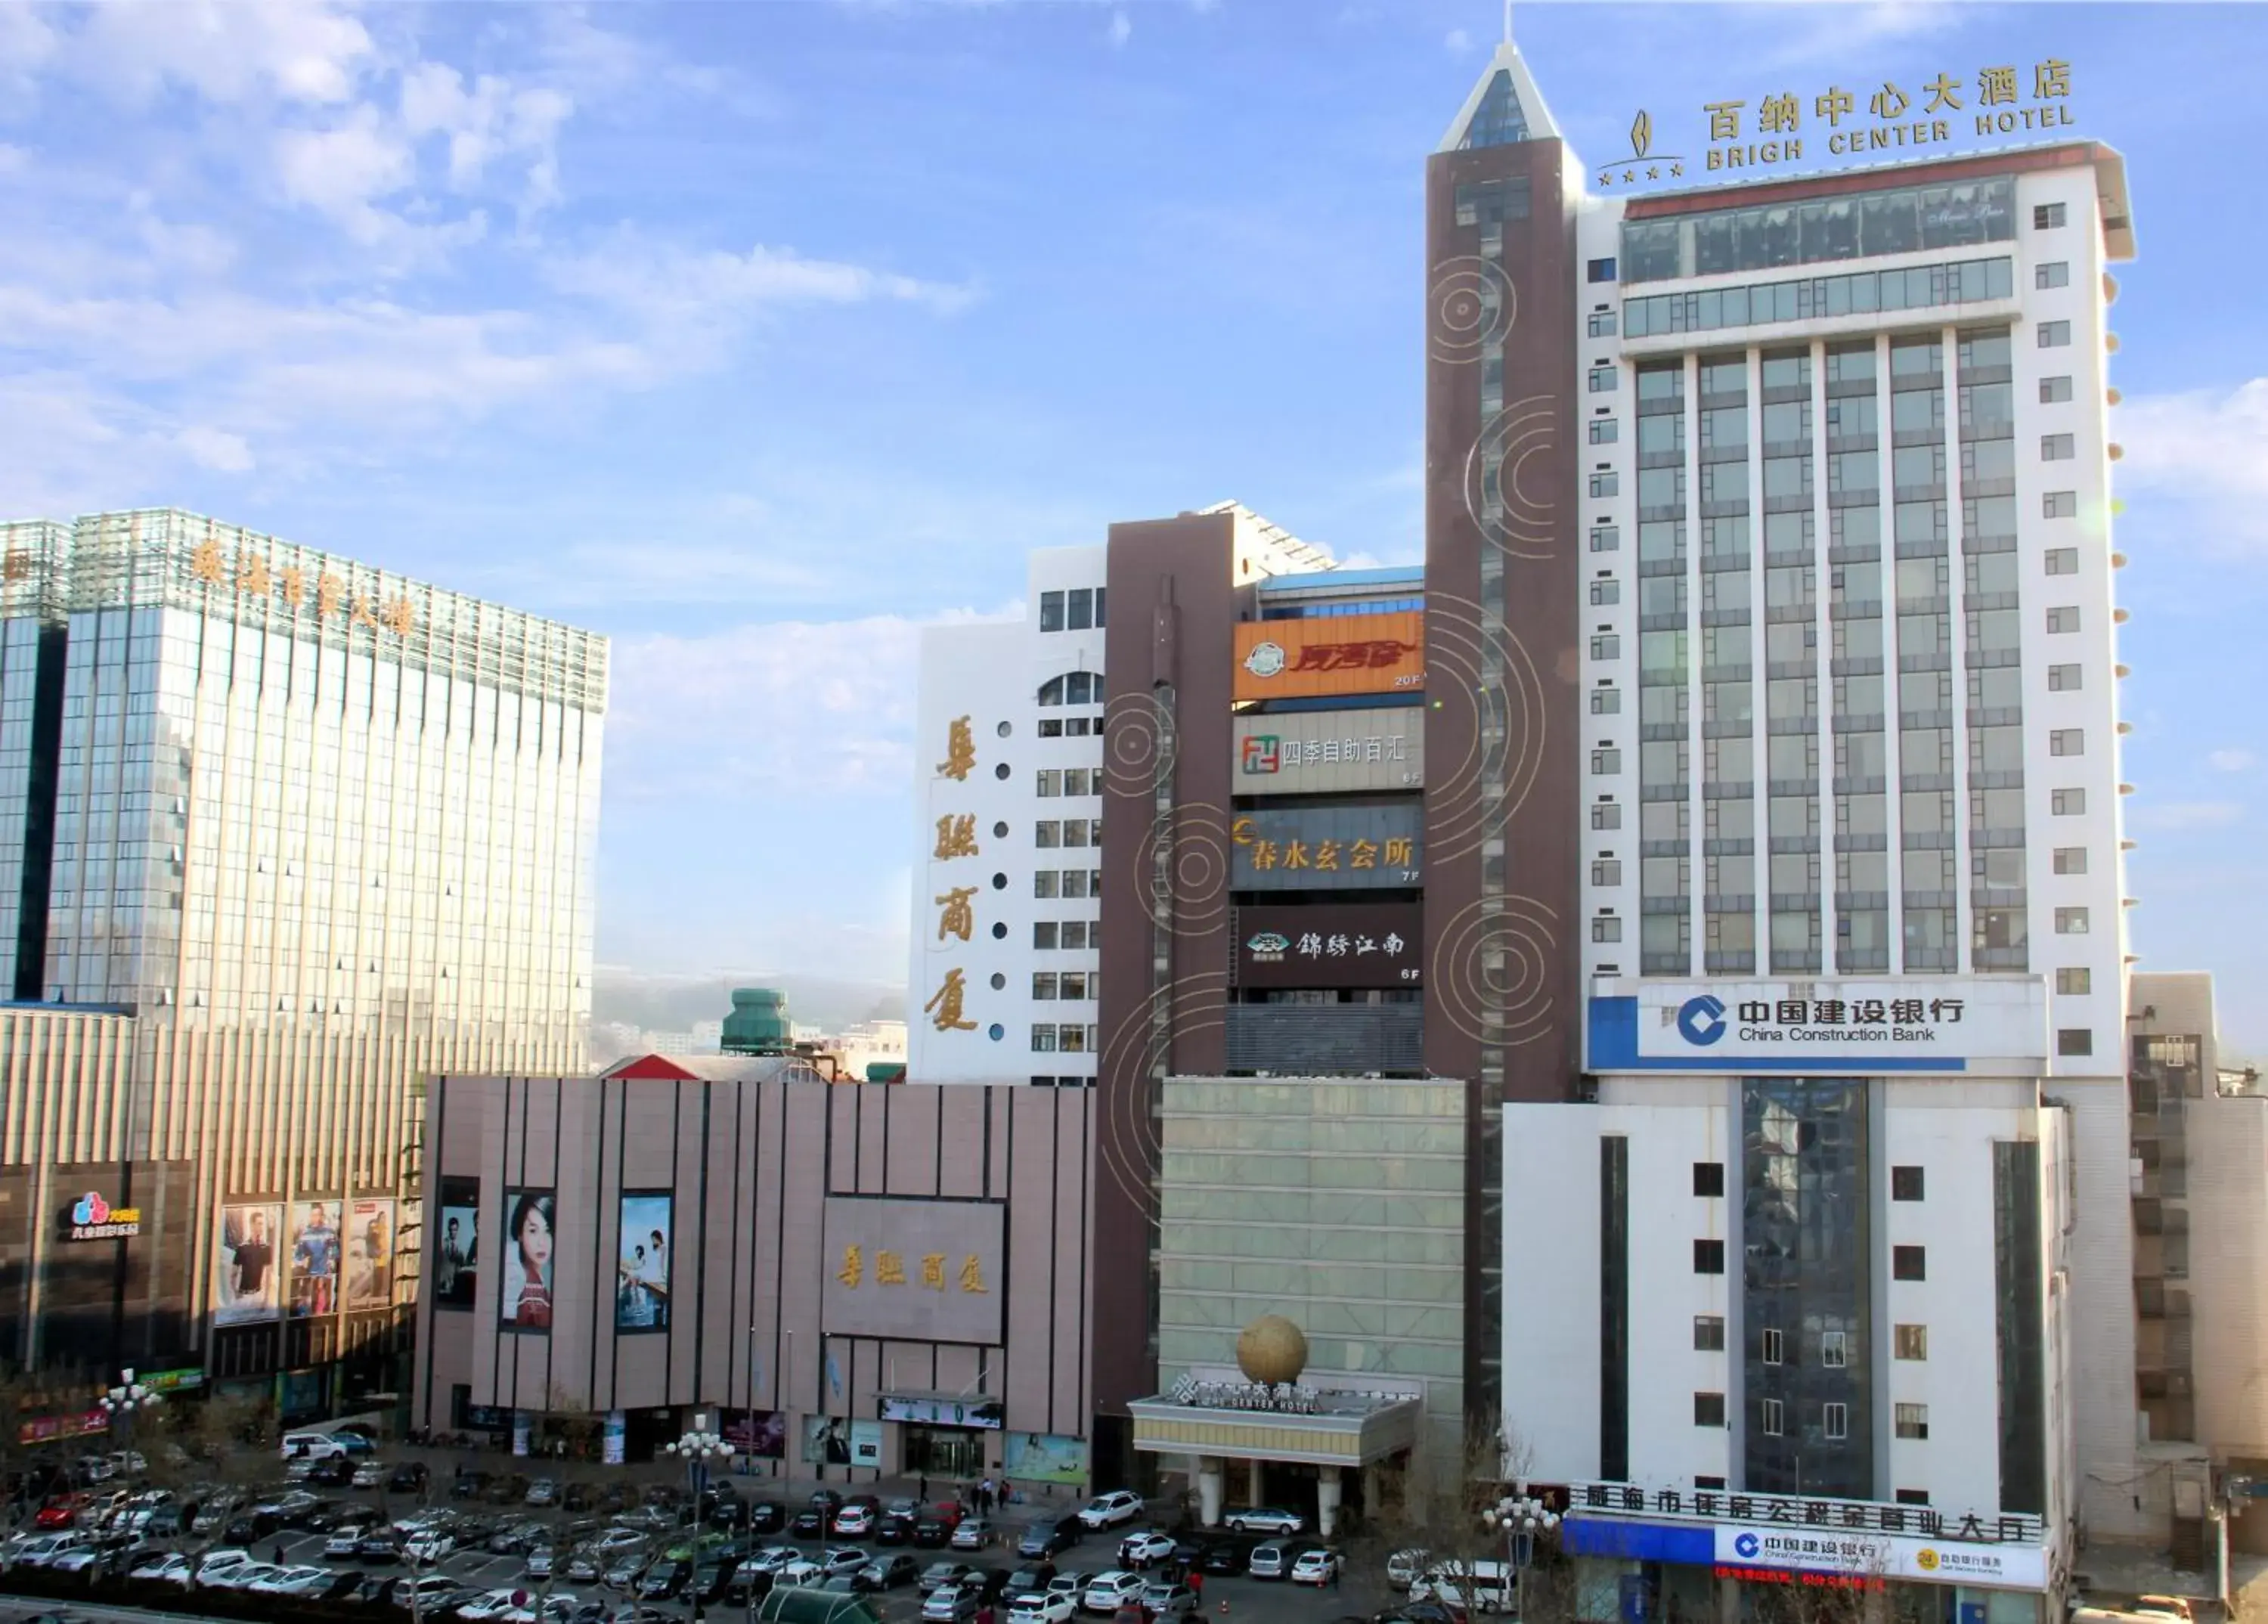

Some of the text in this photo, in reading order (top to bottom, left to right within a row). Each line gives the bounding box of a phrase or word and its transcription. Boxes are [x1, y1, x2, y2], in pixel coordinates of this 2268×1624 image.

[1703, 59, 2071, 141] 百纳中心大酒店
[1706, 104, 2076, 171] BRIGH CENTER HOTEL
[1282, 734, 1405, 767] 四季自助百汇
[1402, 870, 1420, 882] 7F
[1400, 969, 1420, 981] 6F
[1739, 998, 1965, 1026] 中国建设银行
[1739, 1027, 1936, 1042] China Construction Bank
[1765, 1537, 1876, 1557] 中国建设银行
